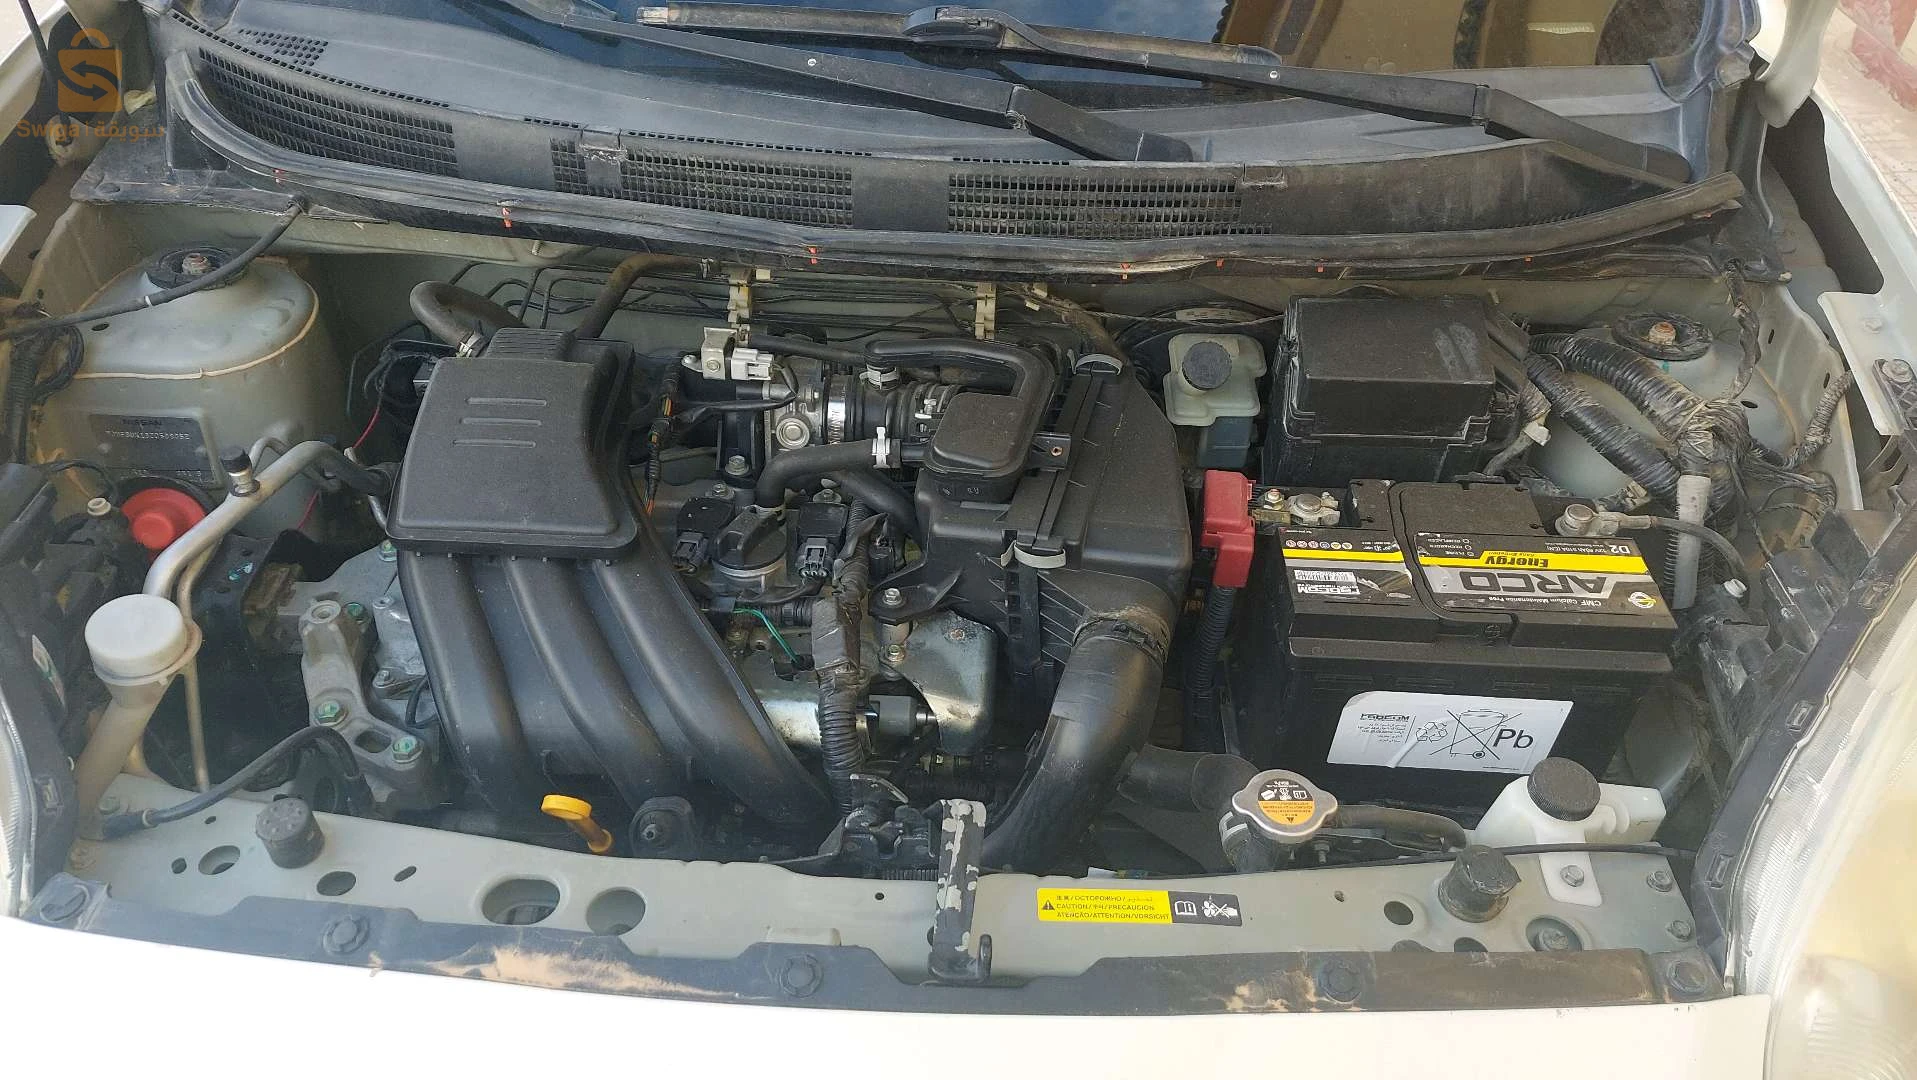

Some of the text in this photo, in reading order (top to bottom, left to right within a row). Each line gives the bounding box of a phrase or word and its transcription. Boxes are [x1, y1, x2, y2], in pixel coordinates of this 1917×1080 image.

[1609, 544, 1631, 554] D2
[1485, 555, 1549, 569] Energy
[1459, 571, 1607, 594] ARCO
[1580, 599, 1602, 607] CMF
[1492, 727, 1535, 750] Pb
